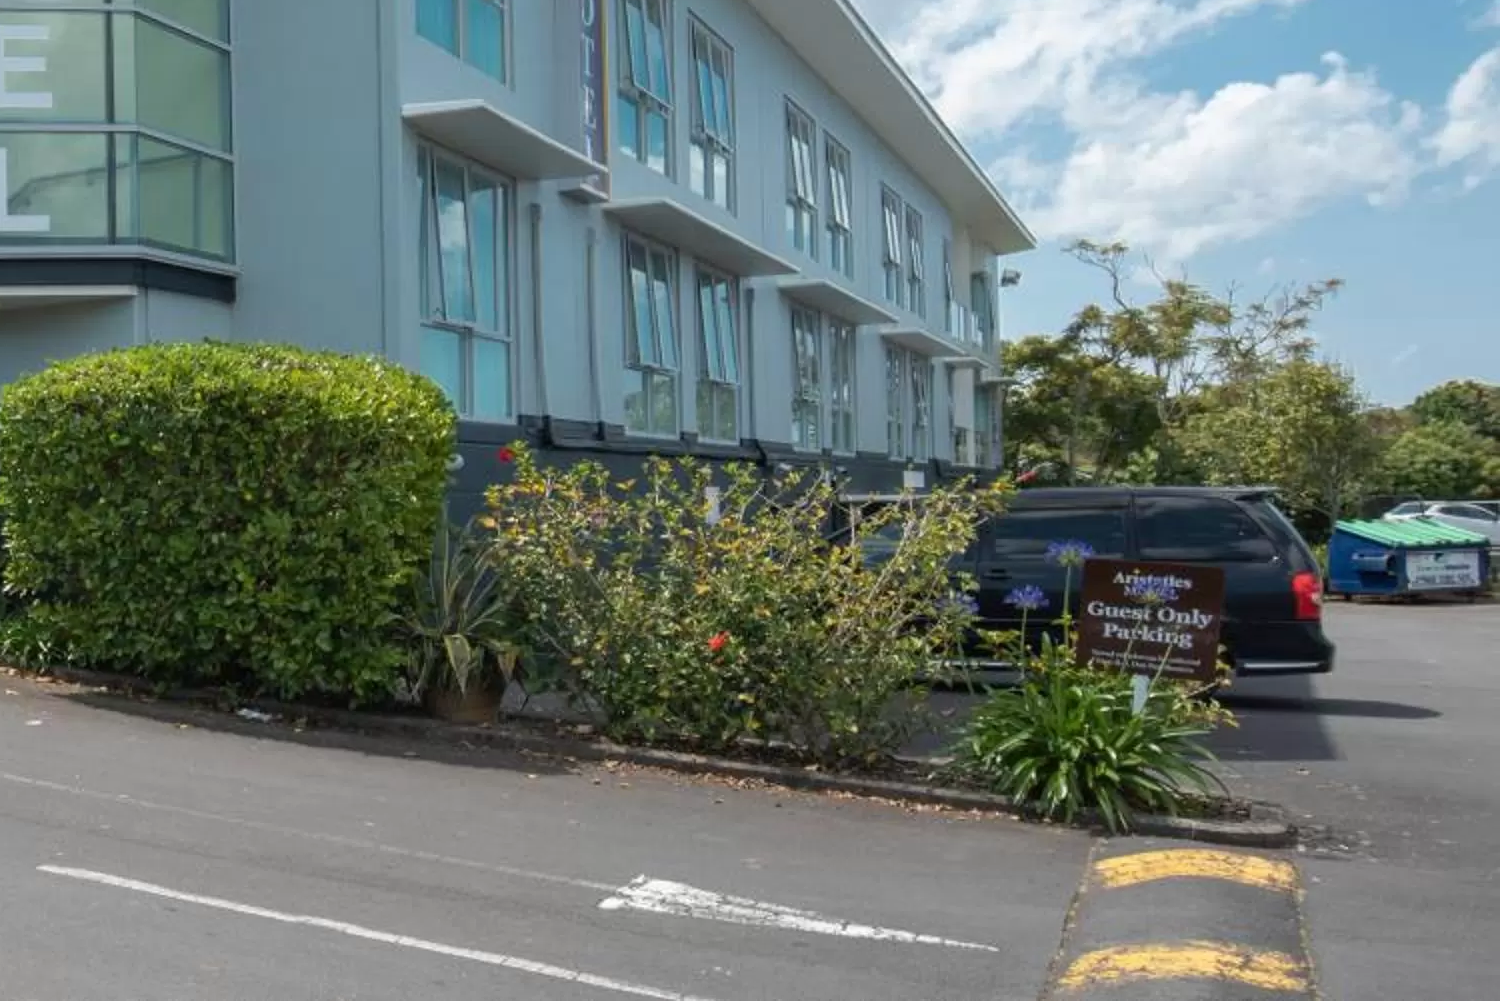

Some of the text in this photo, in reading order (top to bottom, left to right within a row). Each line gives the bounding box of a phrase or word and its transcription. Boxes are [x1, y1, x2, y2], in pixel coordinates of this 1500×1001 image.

[1087, 601, 1213, 629] Guest Only
[1103, 622, 1193, 649] Parking
